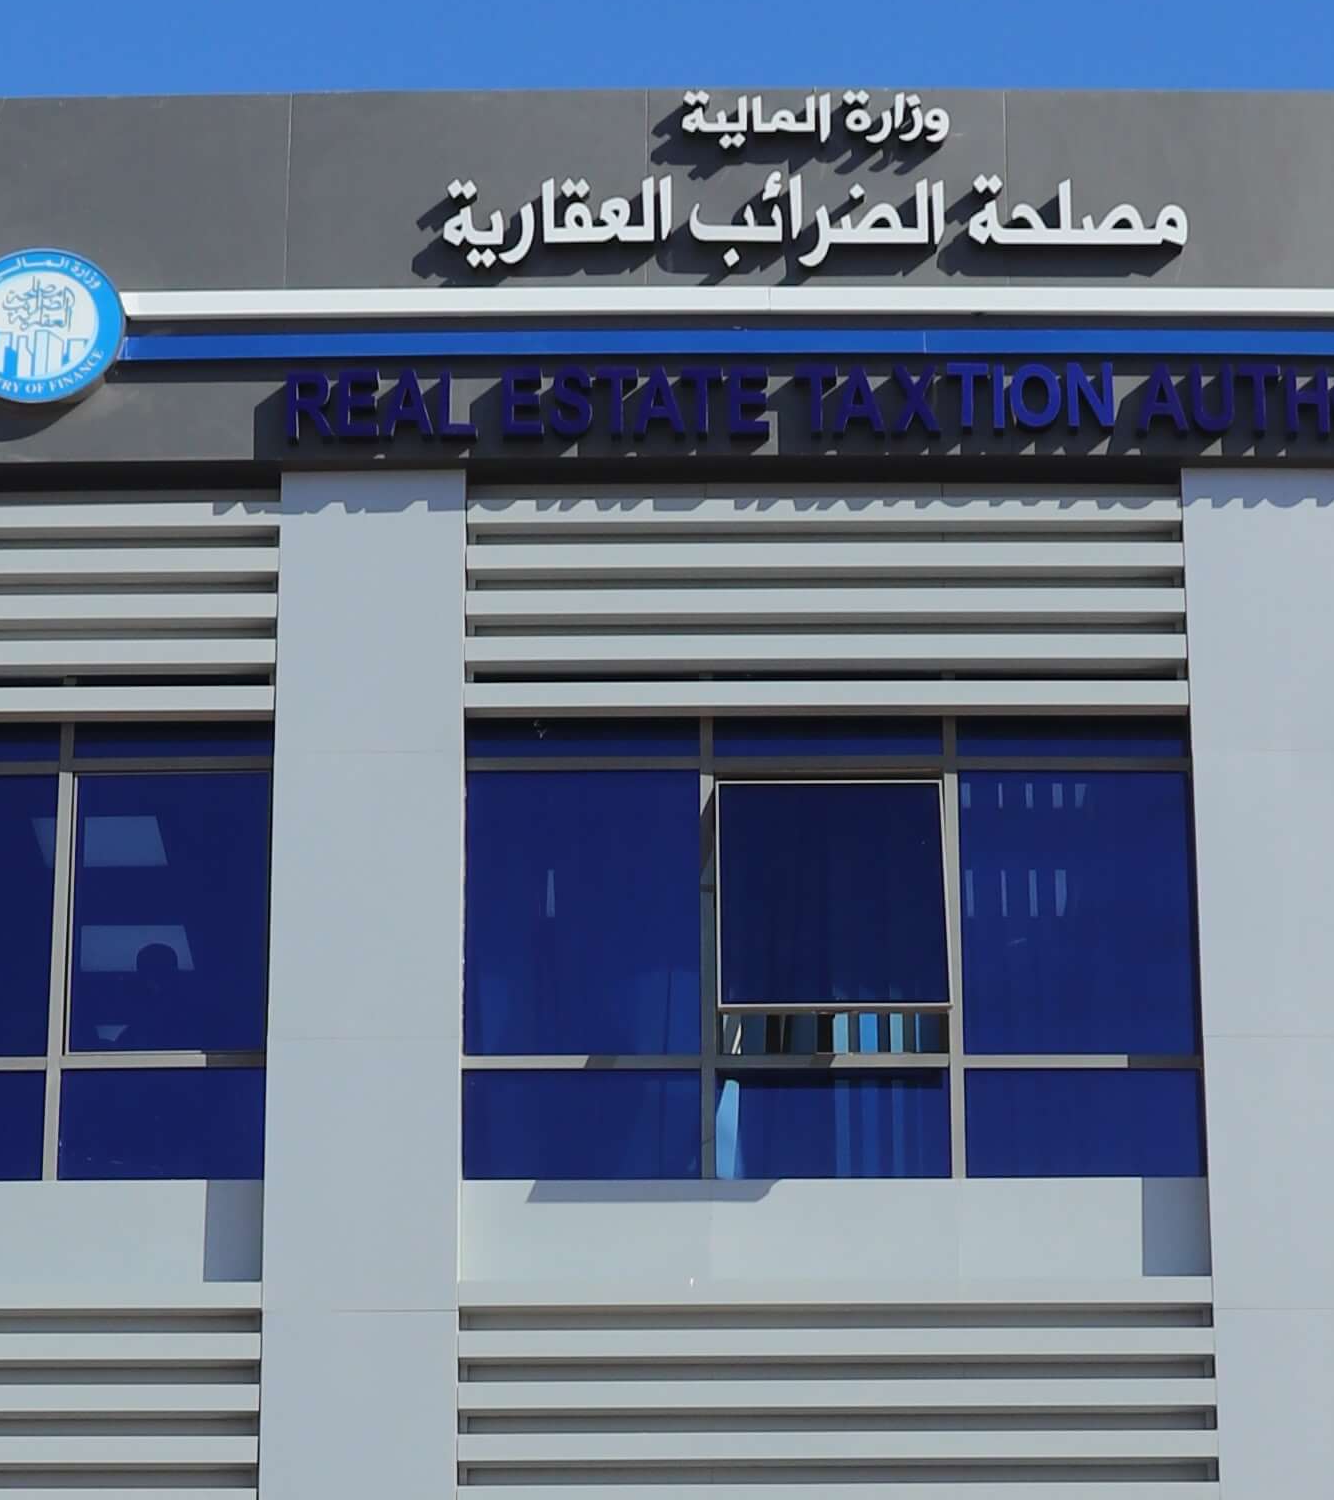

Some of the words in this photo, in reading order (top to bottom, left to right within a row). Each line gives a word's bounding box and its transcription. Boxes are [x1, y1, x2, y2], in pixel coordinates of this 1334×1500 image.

[681, 90, 831, 149] المالية
[843, 90, 949, 144] وزارة
[442, 174, 672, 268] العقارية
[689, 170, 945, 268] الضرائب
[968, 173, 1188, 247] مصلحة
[25, 382, 44, 393] OF
[50, 350, 104, 393] FINANCE
[285, 368, 479, 444] REAL
[501, 366, 772, 443] ESTATE
[793, 361, 1115, 441] TAXTION
